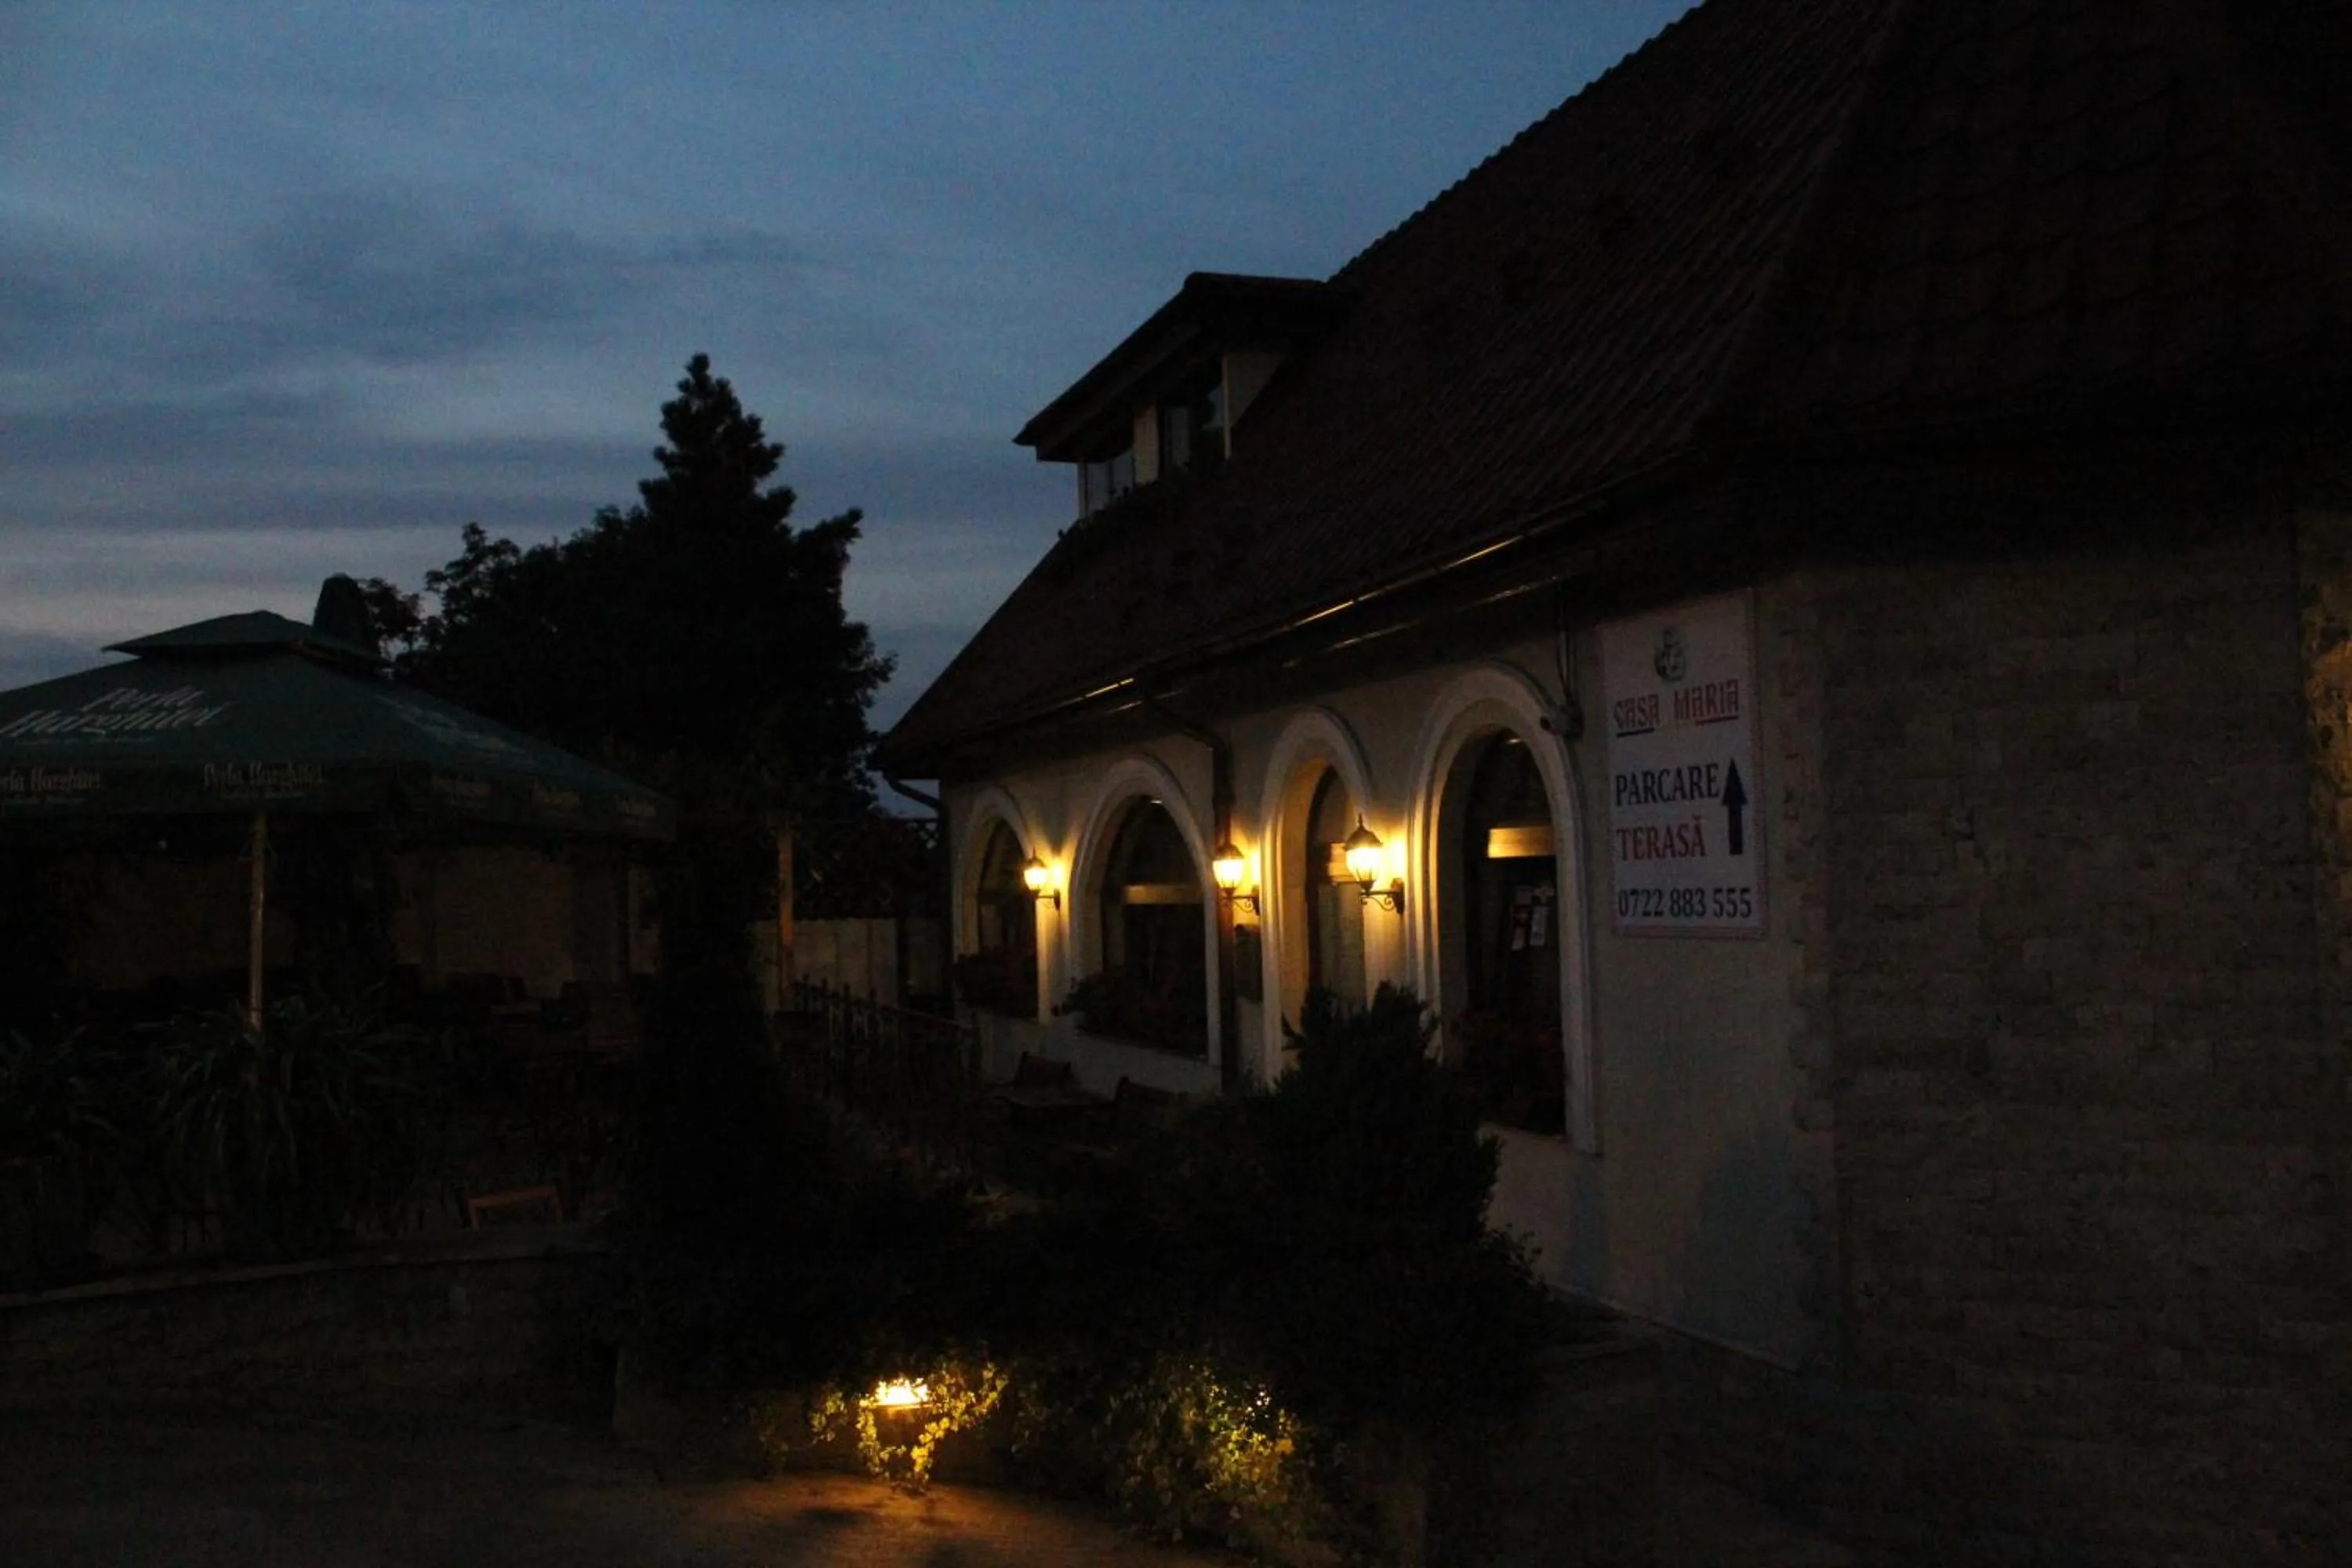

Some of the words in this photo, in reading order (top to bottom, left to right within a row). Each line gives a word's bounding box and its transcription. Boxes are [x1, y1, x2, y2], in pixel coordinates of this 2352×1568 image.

[1613, 693, 1660, 729] CASA
[1674, 679, 1739, 720] MARIA
[1616, 764, 1720, 807] PARCARE
[1616, 812, 1706, 861] TERASĂ
[1617, 887, 1664, 917] 0722
[1669, 887, 1707, 917] 883
[1712, 887, 1752, 918] 555
